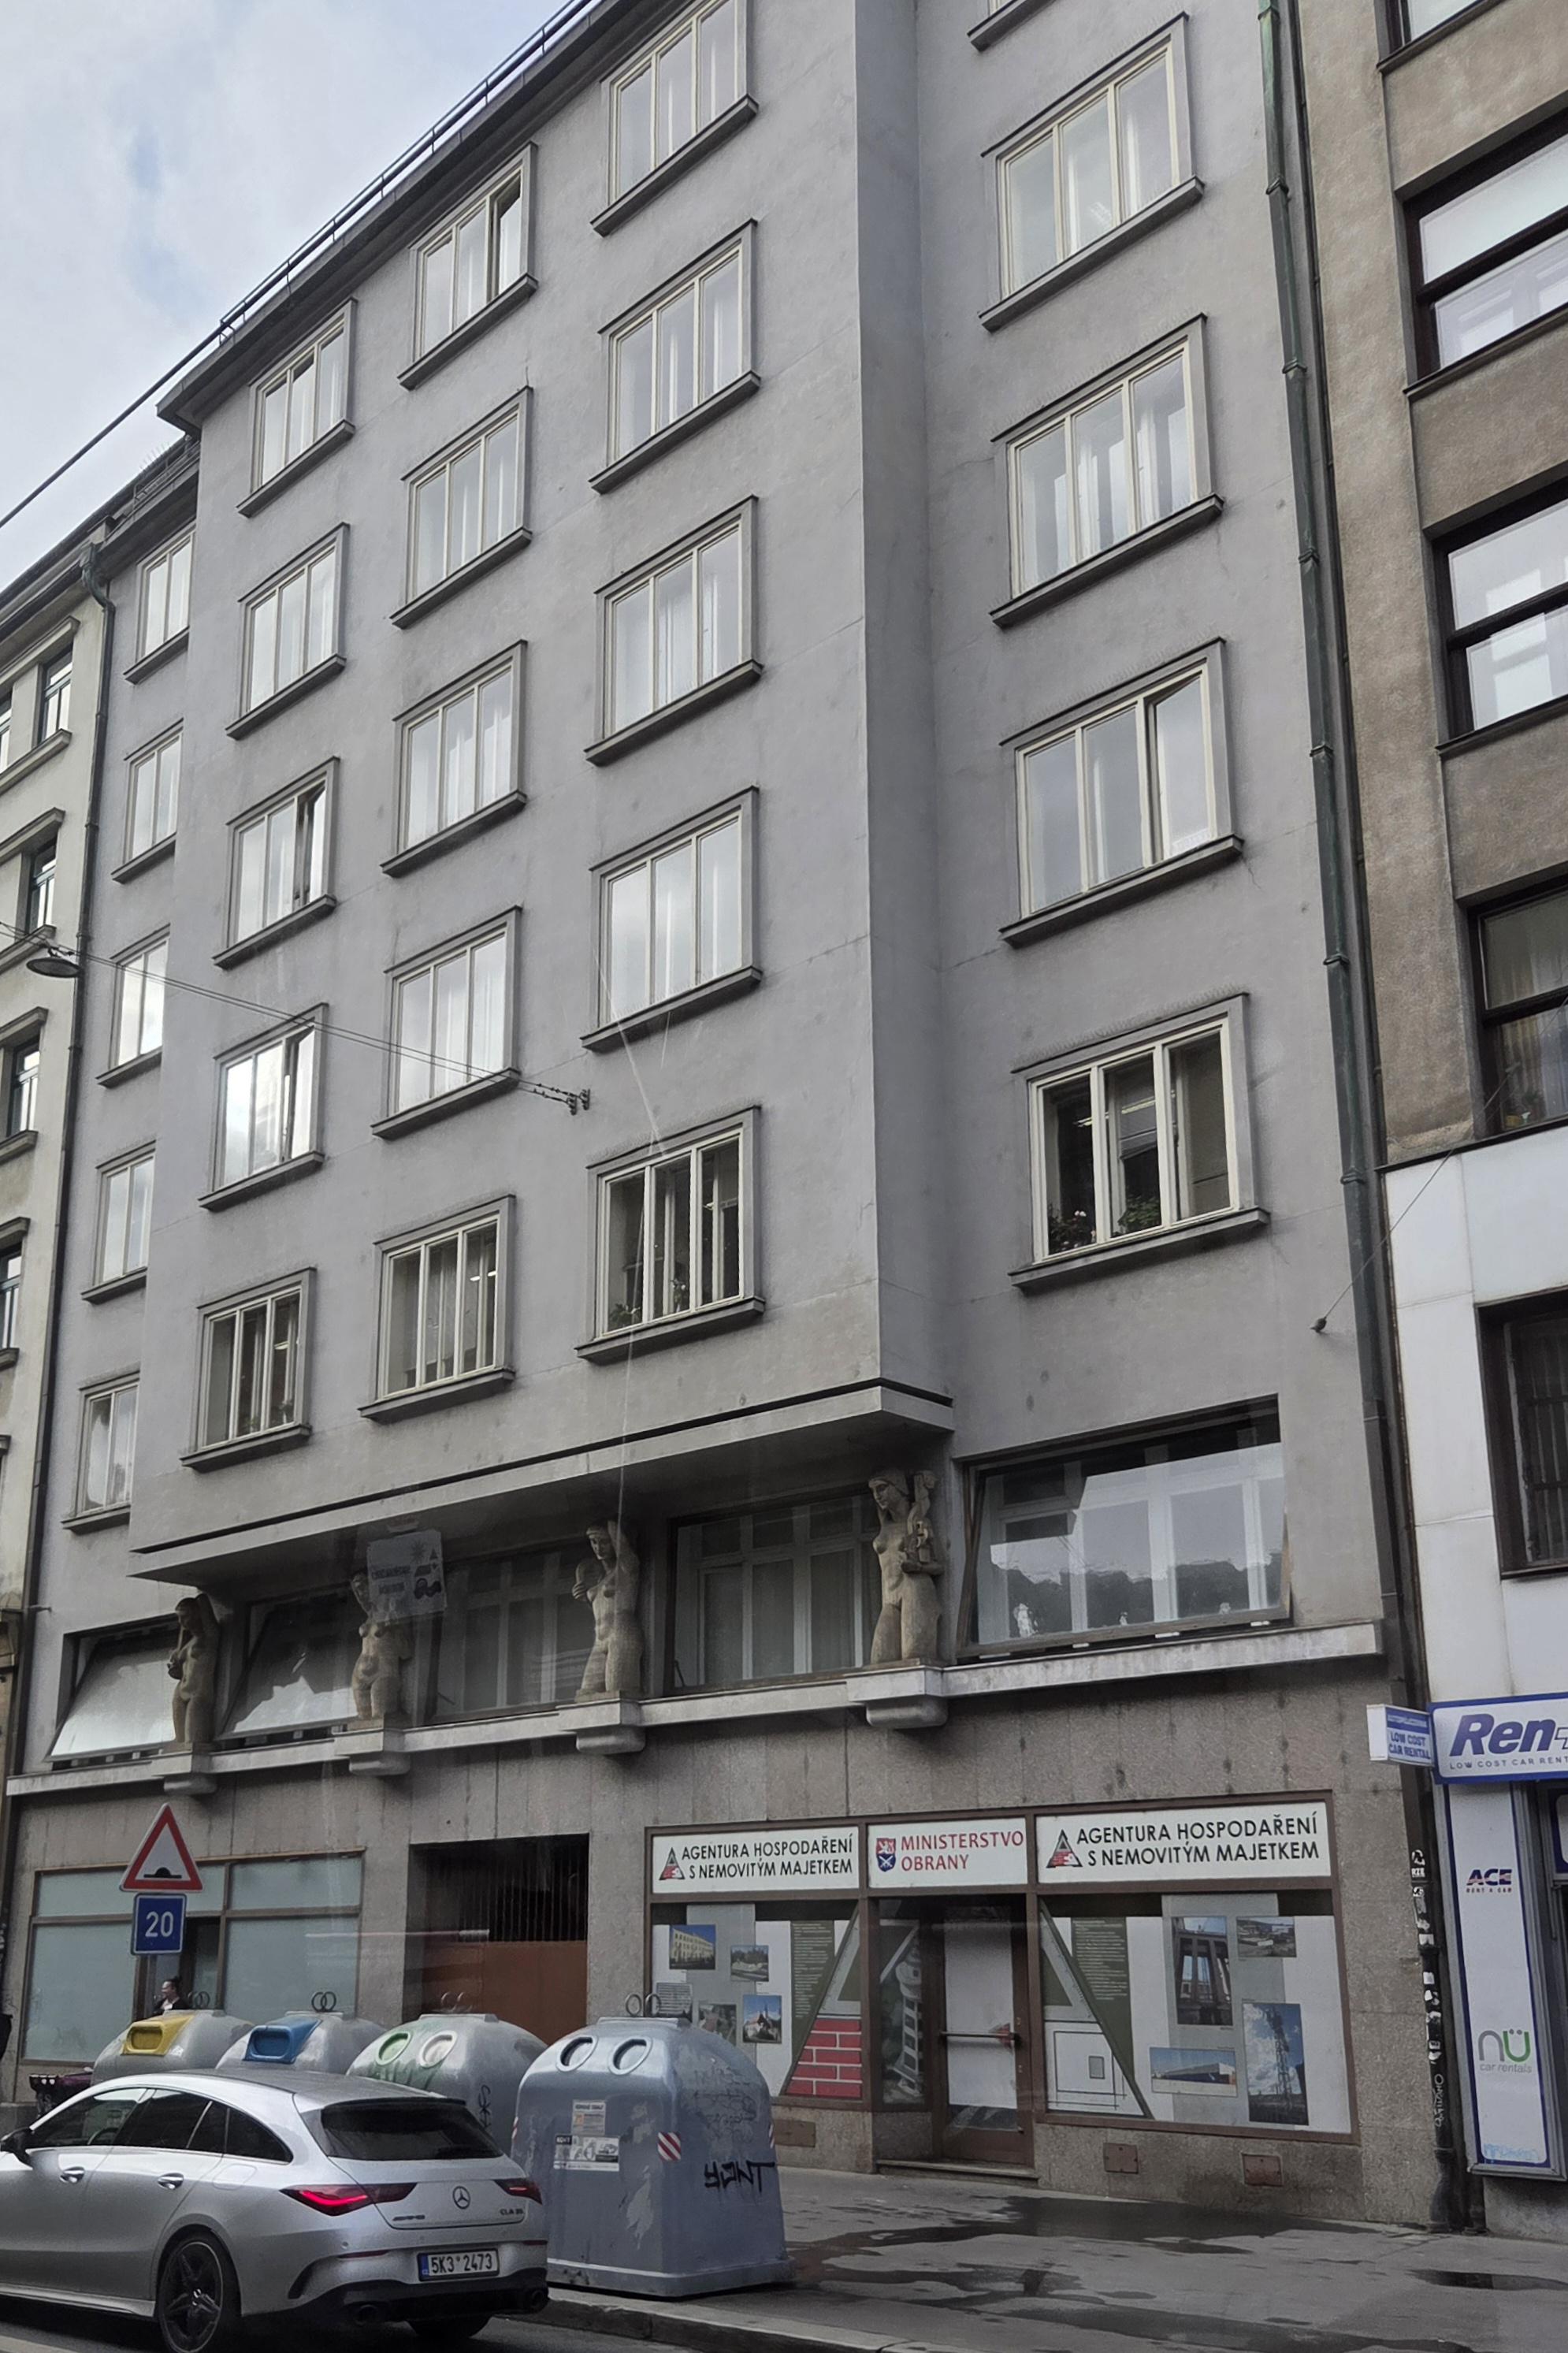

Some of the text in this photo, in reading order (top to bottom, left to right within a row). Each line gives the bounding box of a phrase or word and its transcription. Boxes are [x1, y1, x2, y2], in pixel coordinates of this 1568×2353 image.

[1390, 1731, 1425, 1746] LOW COST
[1389, 1744, 1403, 1755] CAR
[1450, 1761, 1472, 1770] LOW
[1477, 1760, 1507, 1768] COST
[1076, 1811, 1317, 1845] AGENTURA HOSPODAŘENÍ
[682, 1833, 853, 1860] AGENTURA HOSPODAŘENÍ
[901, 1831, 1024, 1850] MINISTERSTVO
[901, 1853, 969, 1872] OBRANY
[1087, 1841, 1319, 1867] S NEMOVITÝM MAJETKEM
[689, 1857, 853, 1879] S NEMOVITÝM MAJETKEM
[1466, 1868, 1512, 1886] ACE
[145, 1911, 173, 1937] 20
[1480, 2062, 1532, 2073] car rentals
[431, 2253, 492, 2273] 5K3 2473
